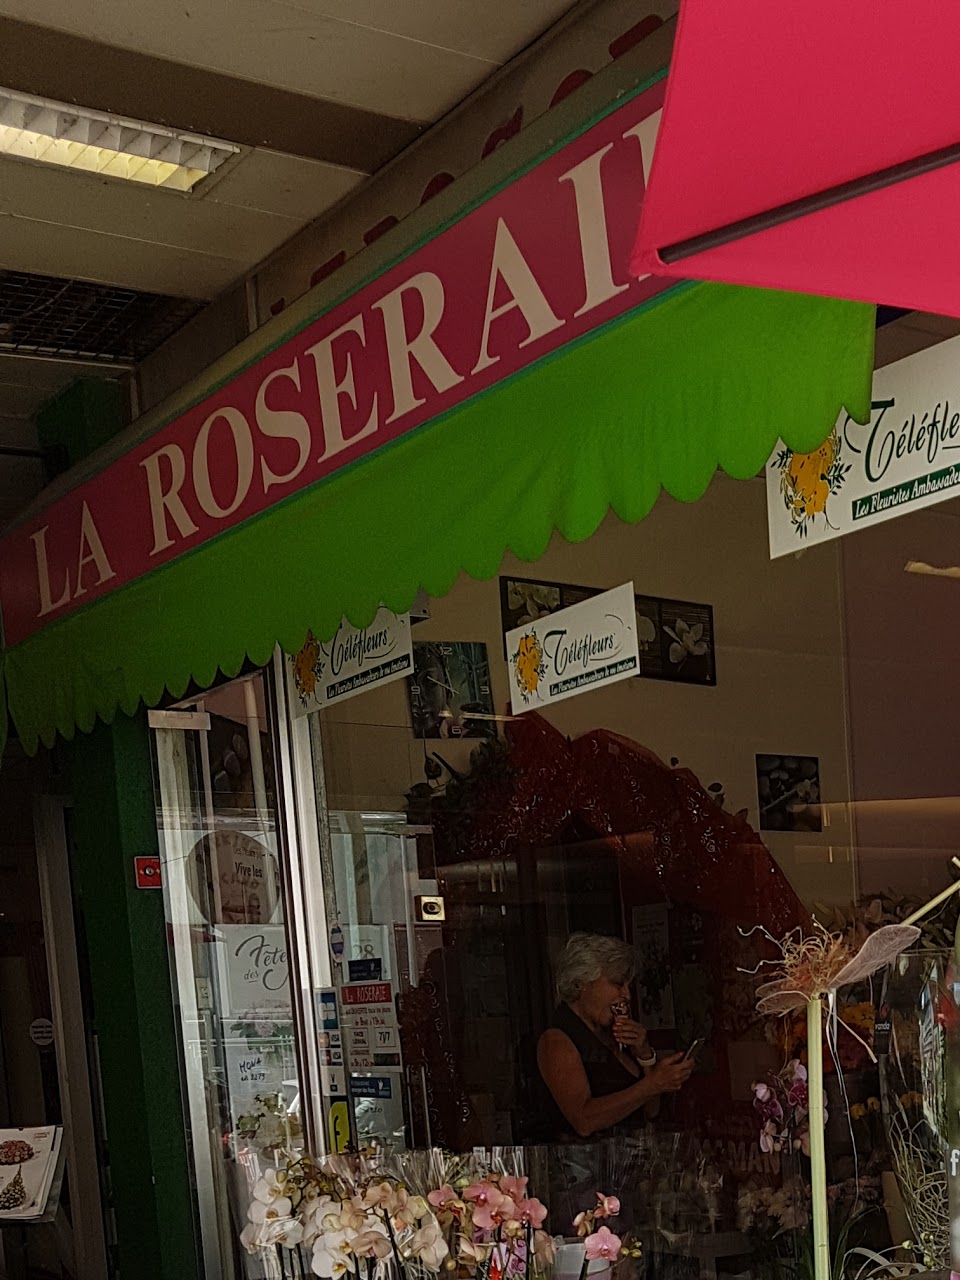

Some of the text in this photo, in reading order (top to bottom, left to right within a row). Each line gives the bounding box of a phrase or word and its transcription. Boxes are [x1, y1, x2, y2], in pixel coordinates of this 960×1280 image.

[30, 105, 664, 617] LA ROSERAI
[854, 500, 870, 518] Les
[870, 487, 910, 512] Fleuristes
[543, 629, 614, 676] Téléfleurs
[234, 862, 252, 877] Vive
[252, 865, 263, 878] les
